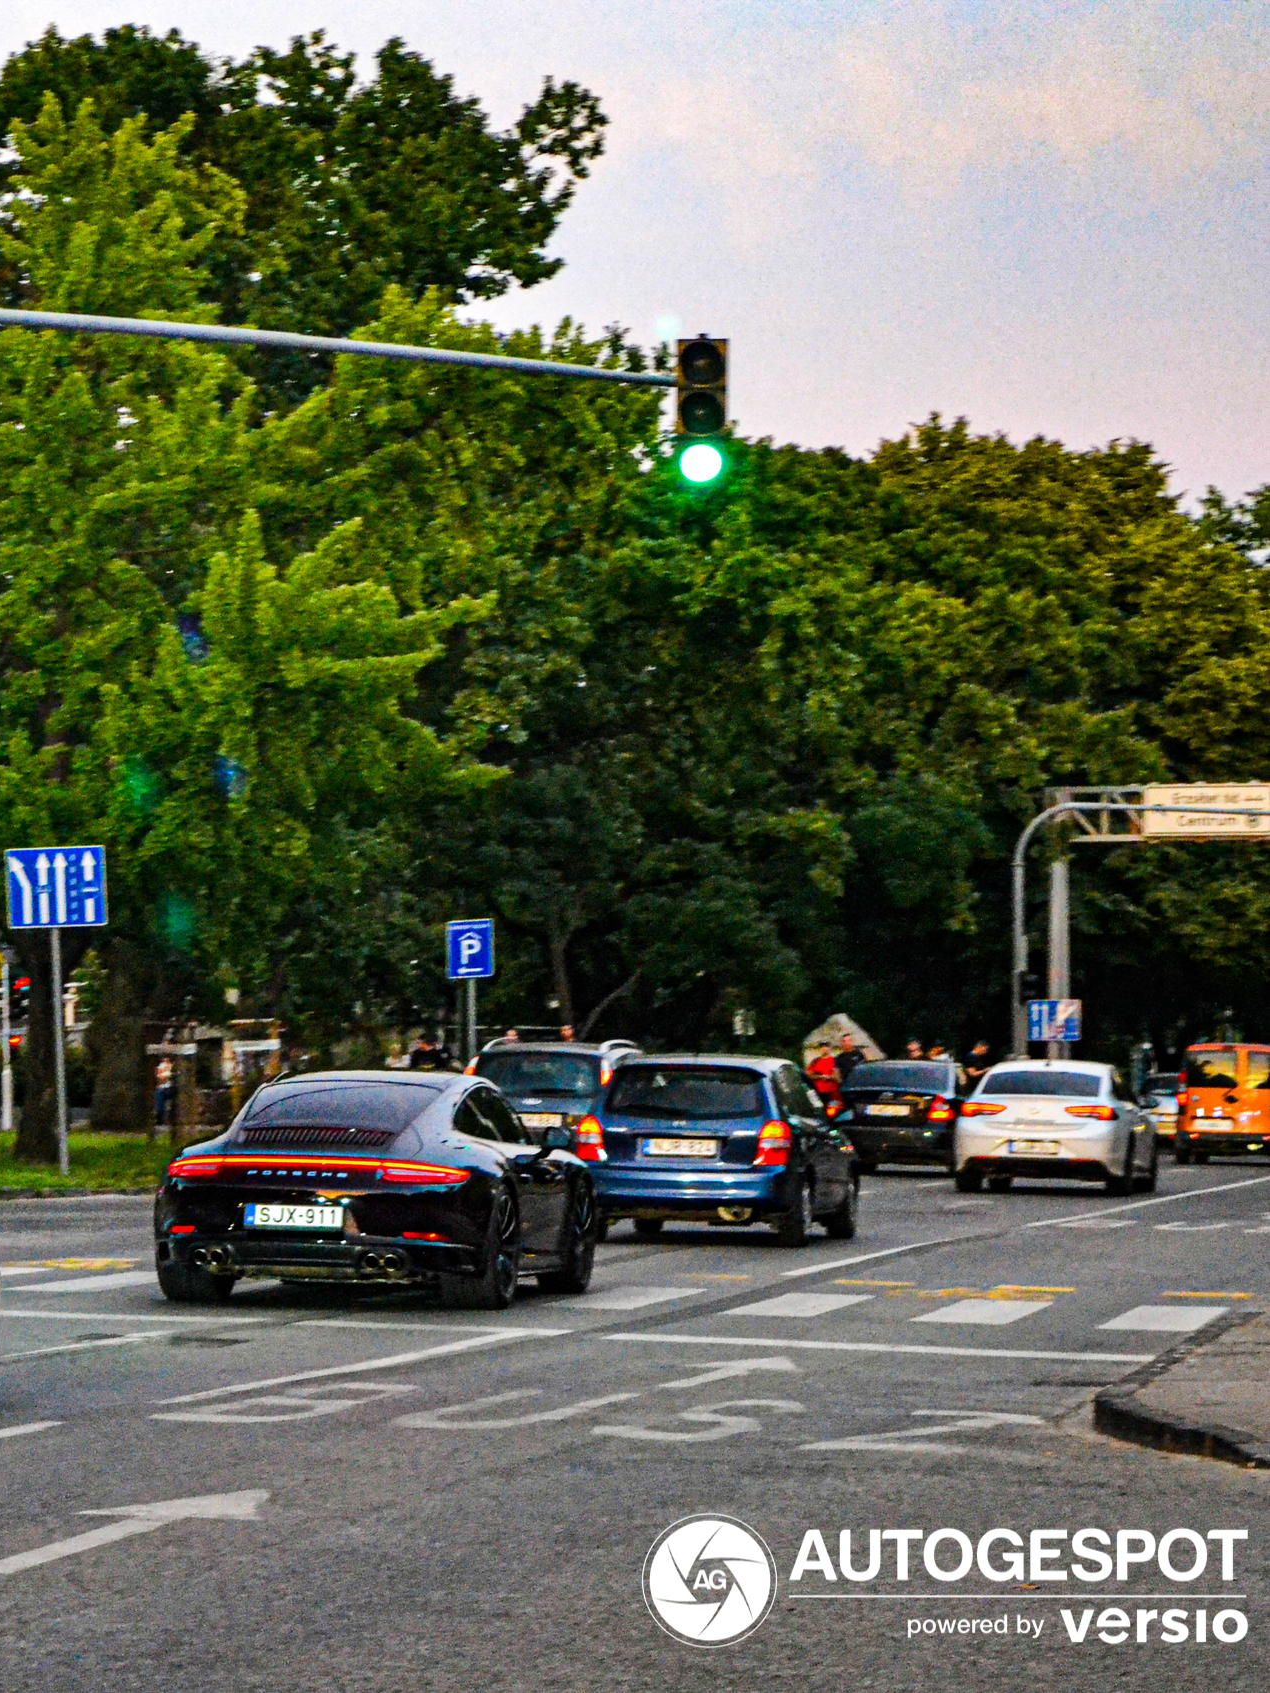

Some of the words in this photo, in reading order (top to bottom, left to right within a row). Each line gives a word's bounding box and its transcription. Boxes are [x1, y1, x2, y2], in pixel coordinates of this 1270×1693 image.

[460, 939, 482, 965] P
[247, 1169, 348, 1178] PORSCHE
[259, 1207, 336, 1224] SJX-911
